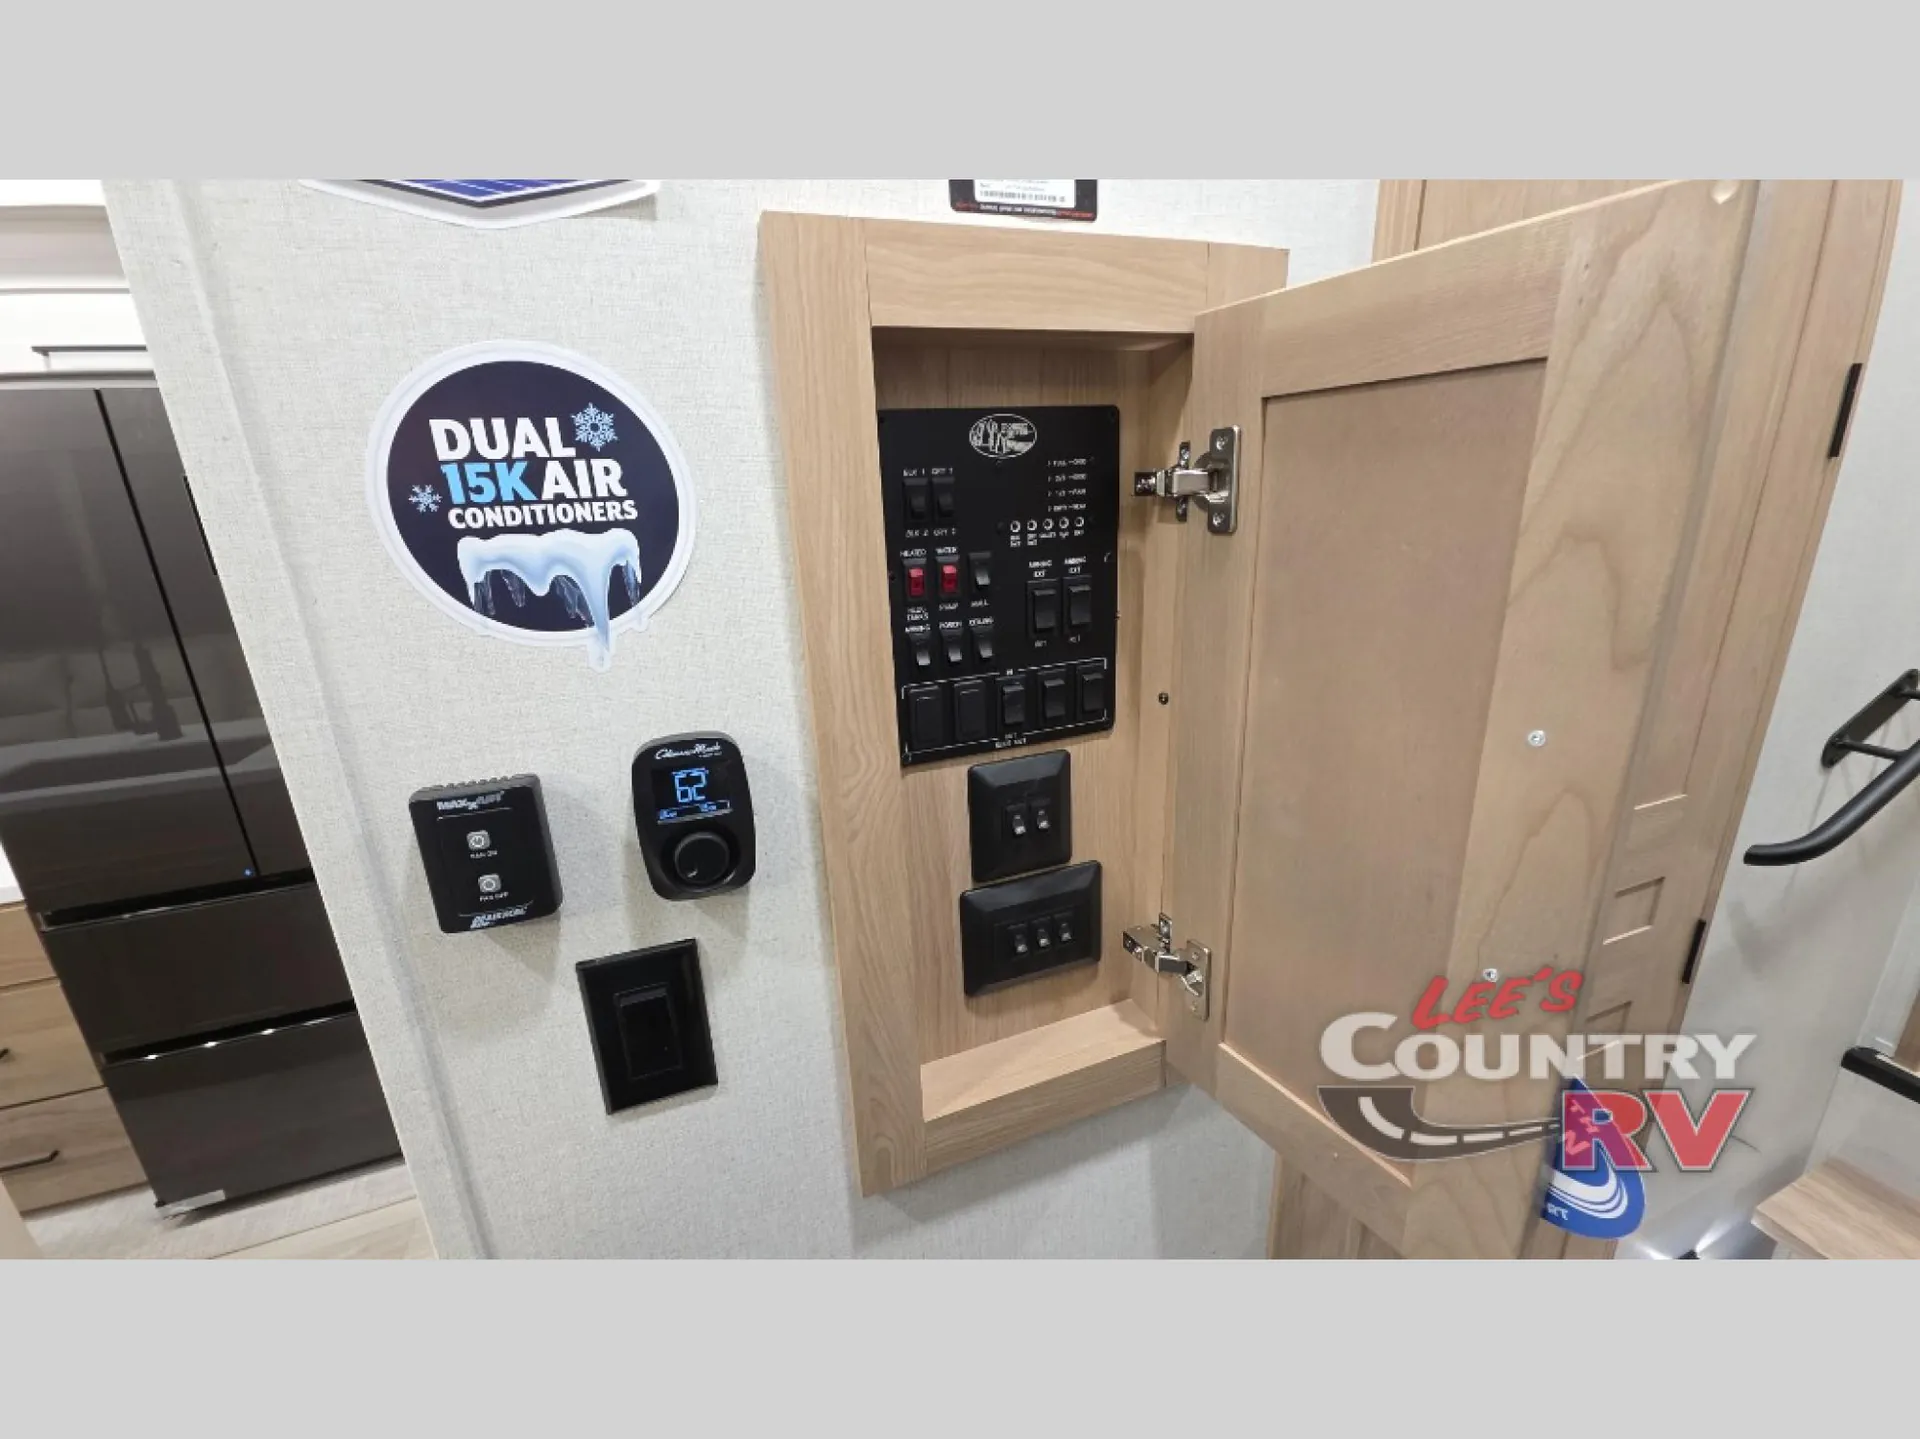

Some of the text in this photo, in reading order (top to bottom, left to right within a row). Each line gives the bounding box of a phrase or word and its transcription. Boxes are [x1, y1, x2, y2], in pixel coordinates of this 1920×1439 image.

[429, 417, 577, 461] DUAL
[440, 458, 629, 505] 15K AIR
[448, 500, 639, 529] CONDITIONERS
